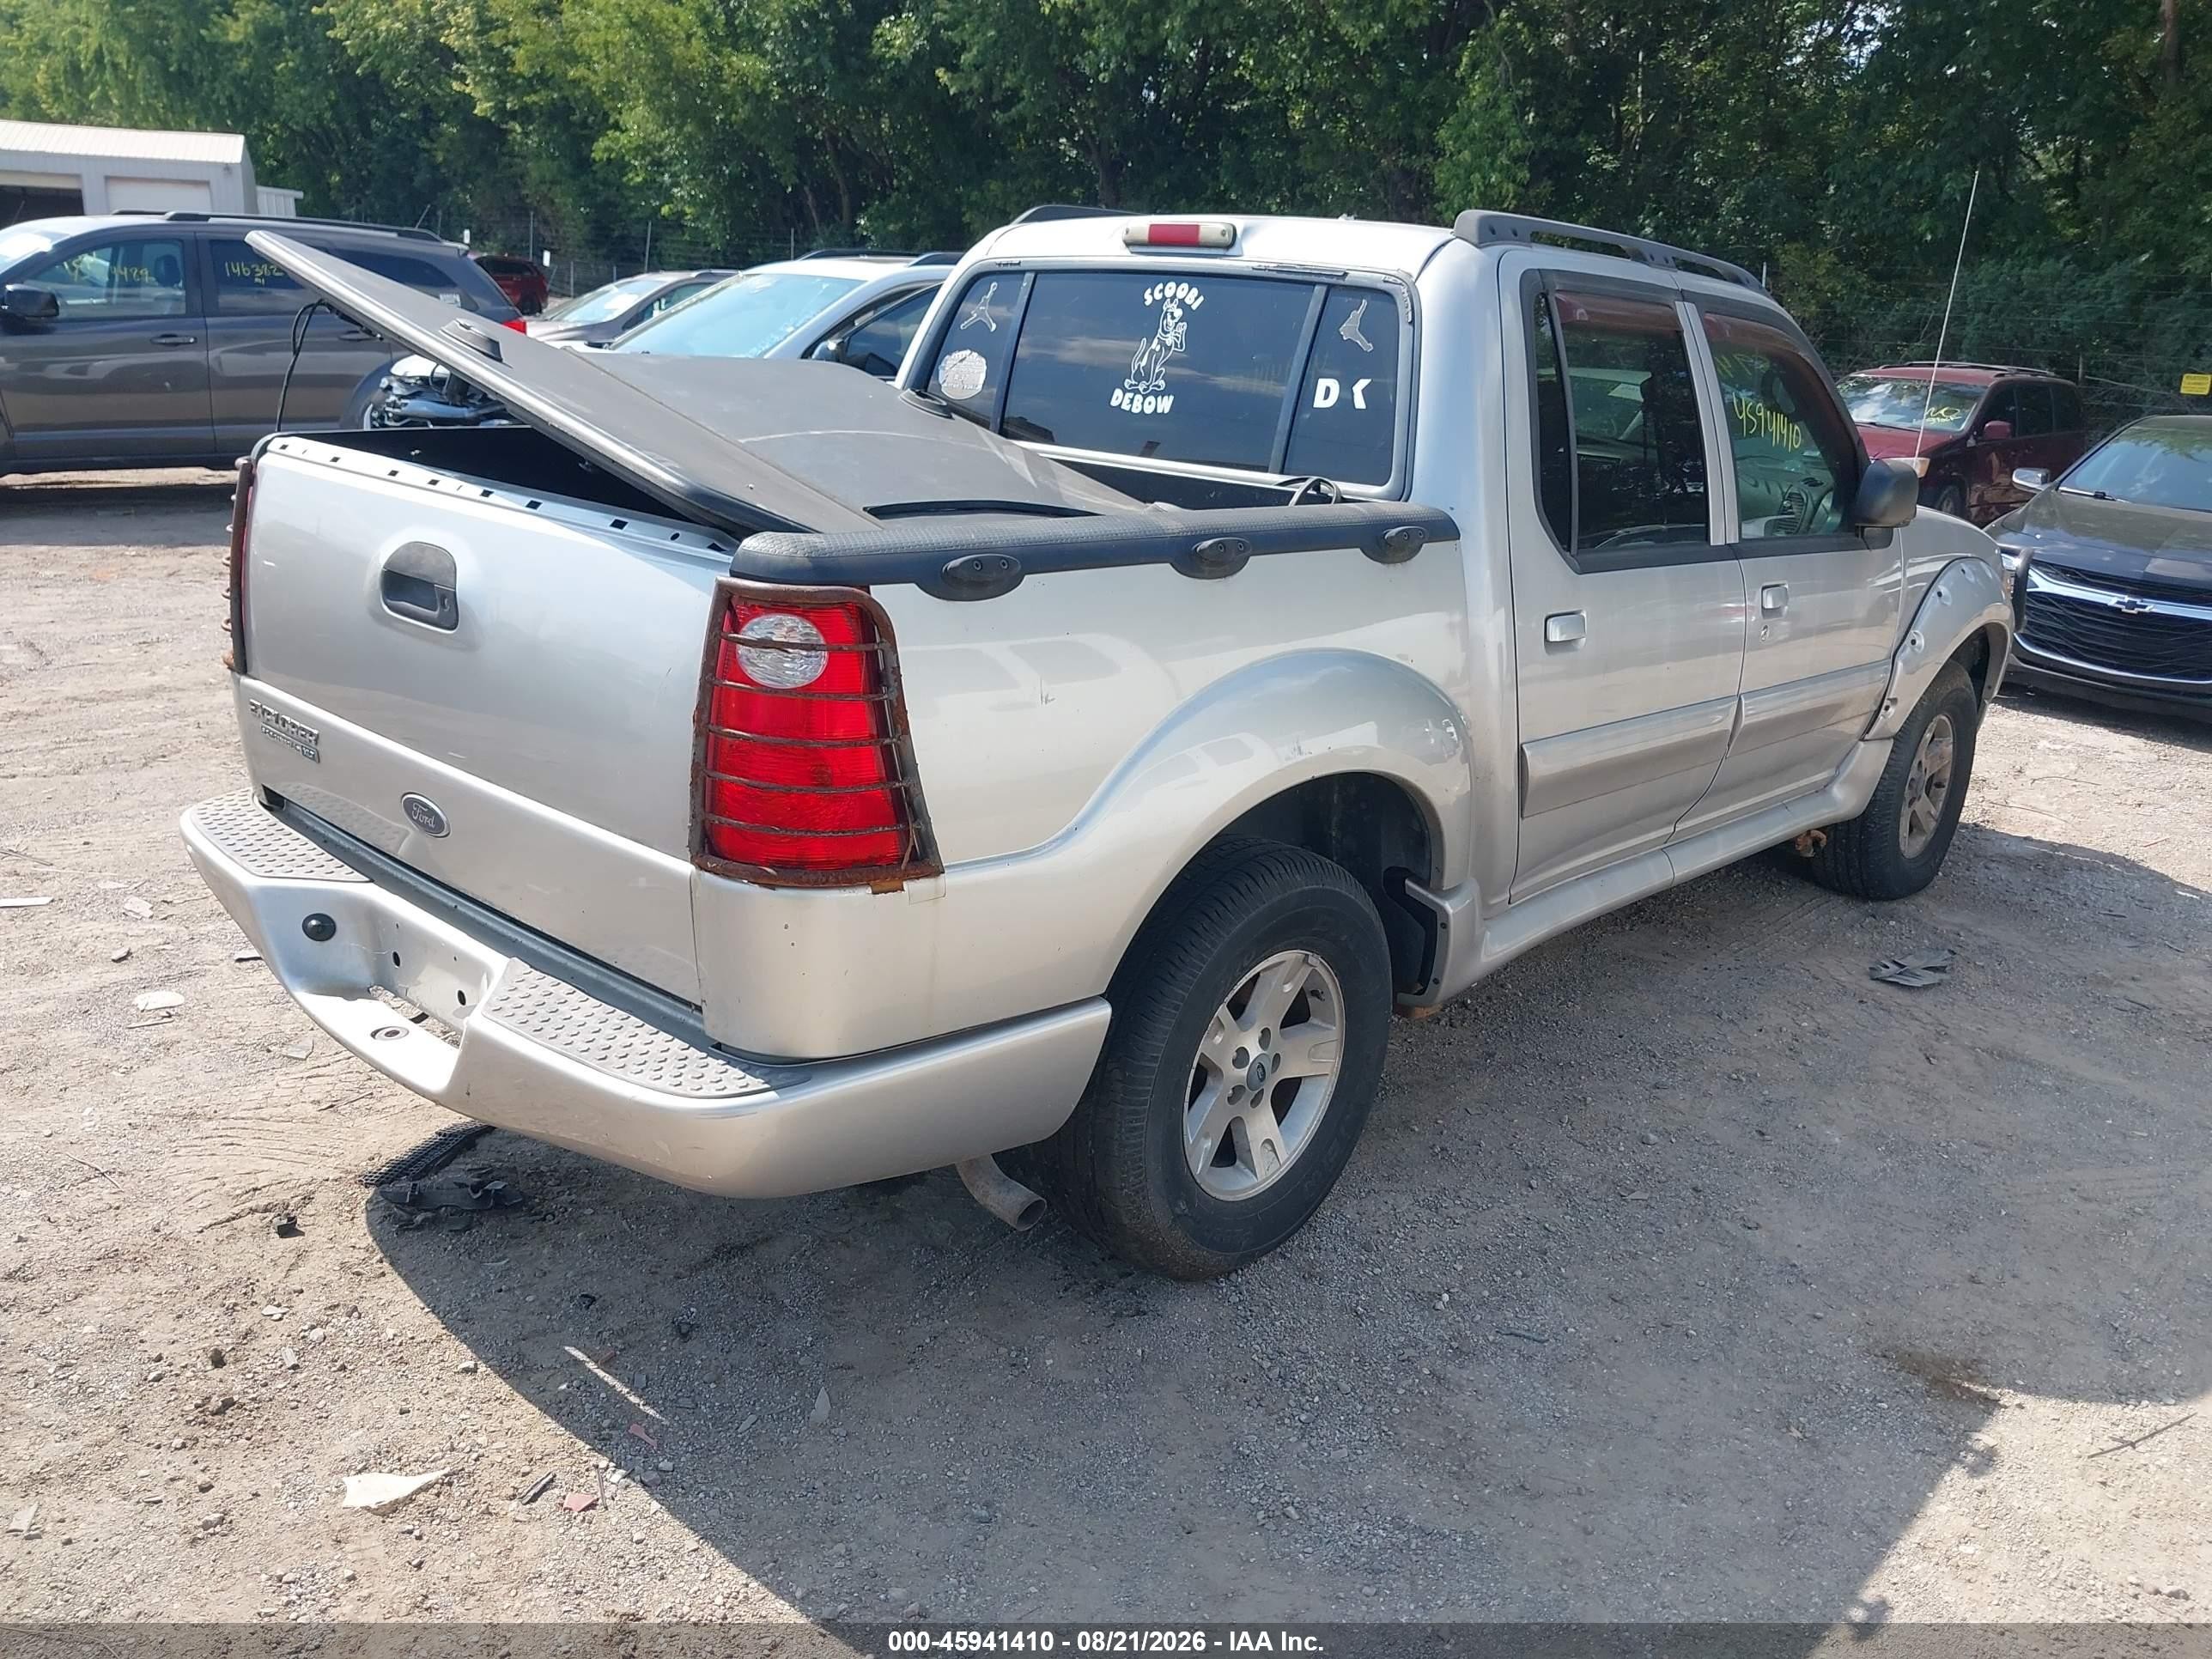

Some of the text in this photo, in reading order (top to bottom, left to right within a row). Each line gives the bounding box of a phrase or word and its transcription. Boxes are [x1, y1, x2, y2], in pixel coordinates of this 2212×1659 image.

[1144, 282, 1204, 310] SCOOBI
[1110, 388, 1174, 414] DEBOW
[1733, 392, 1802, 453] 45941410
[412, 802, 435, 829] Ford
